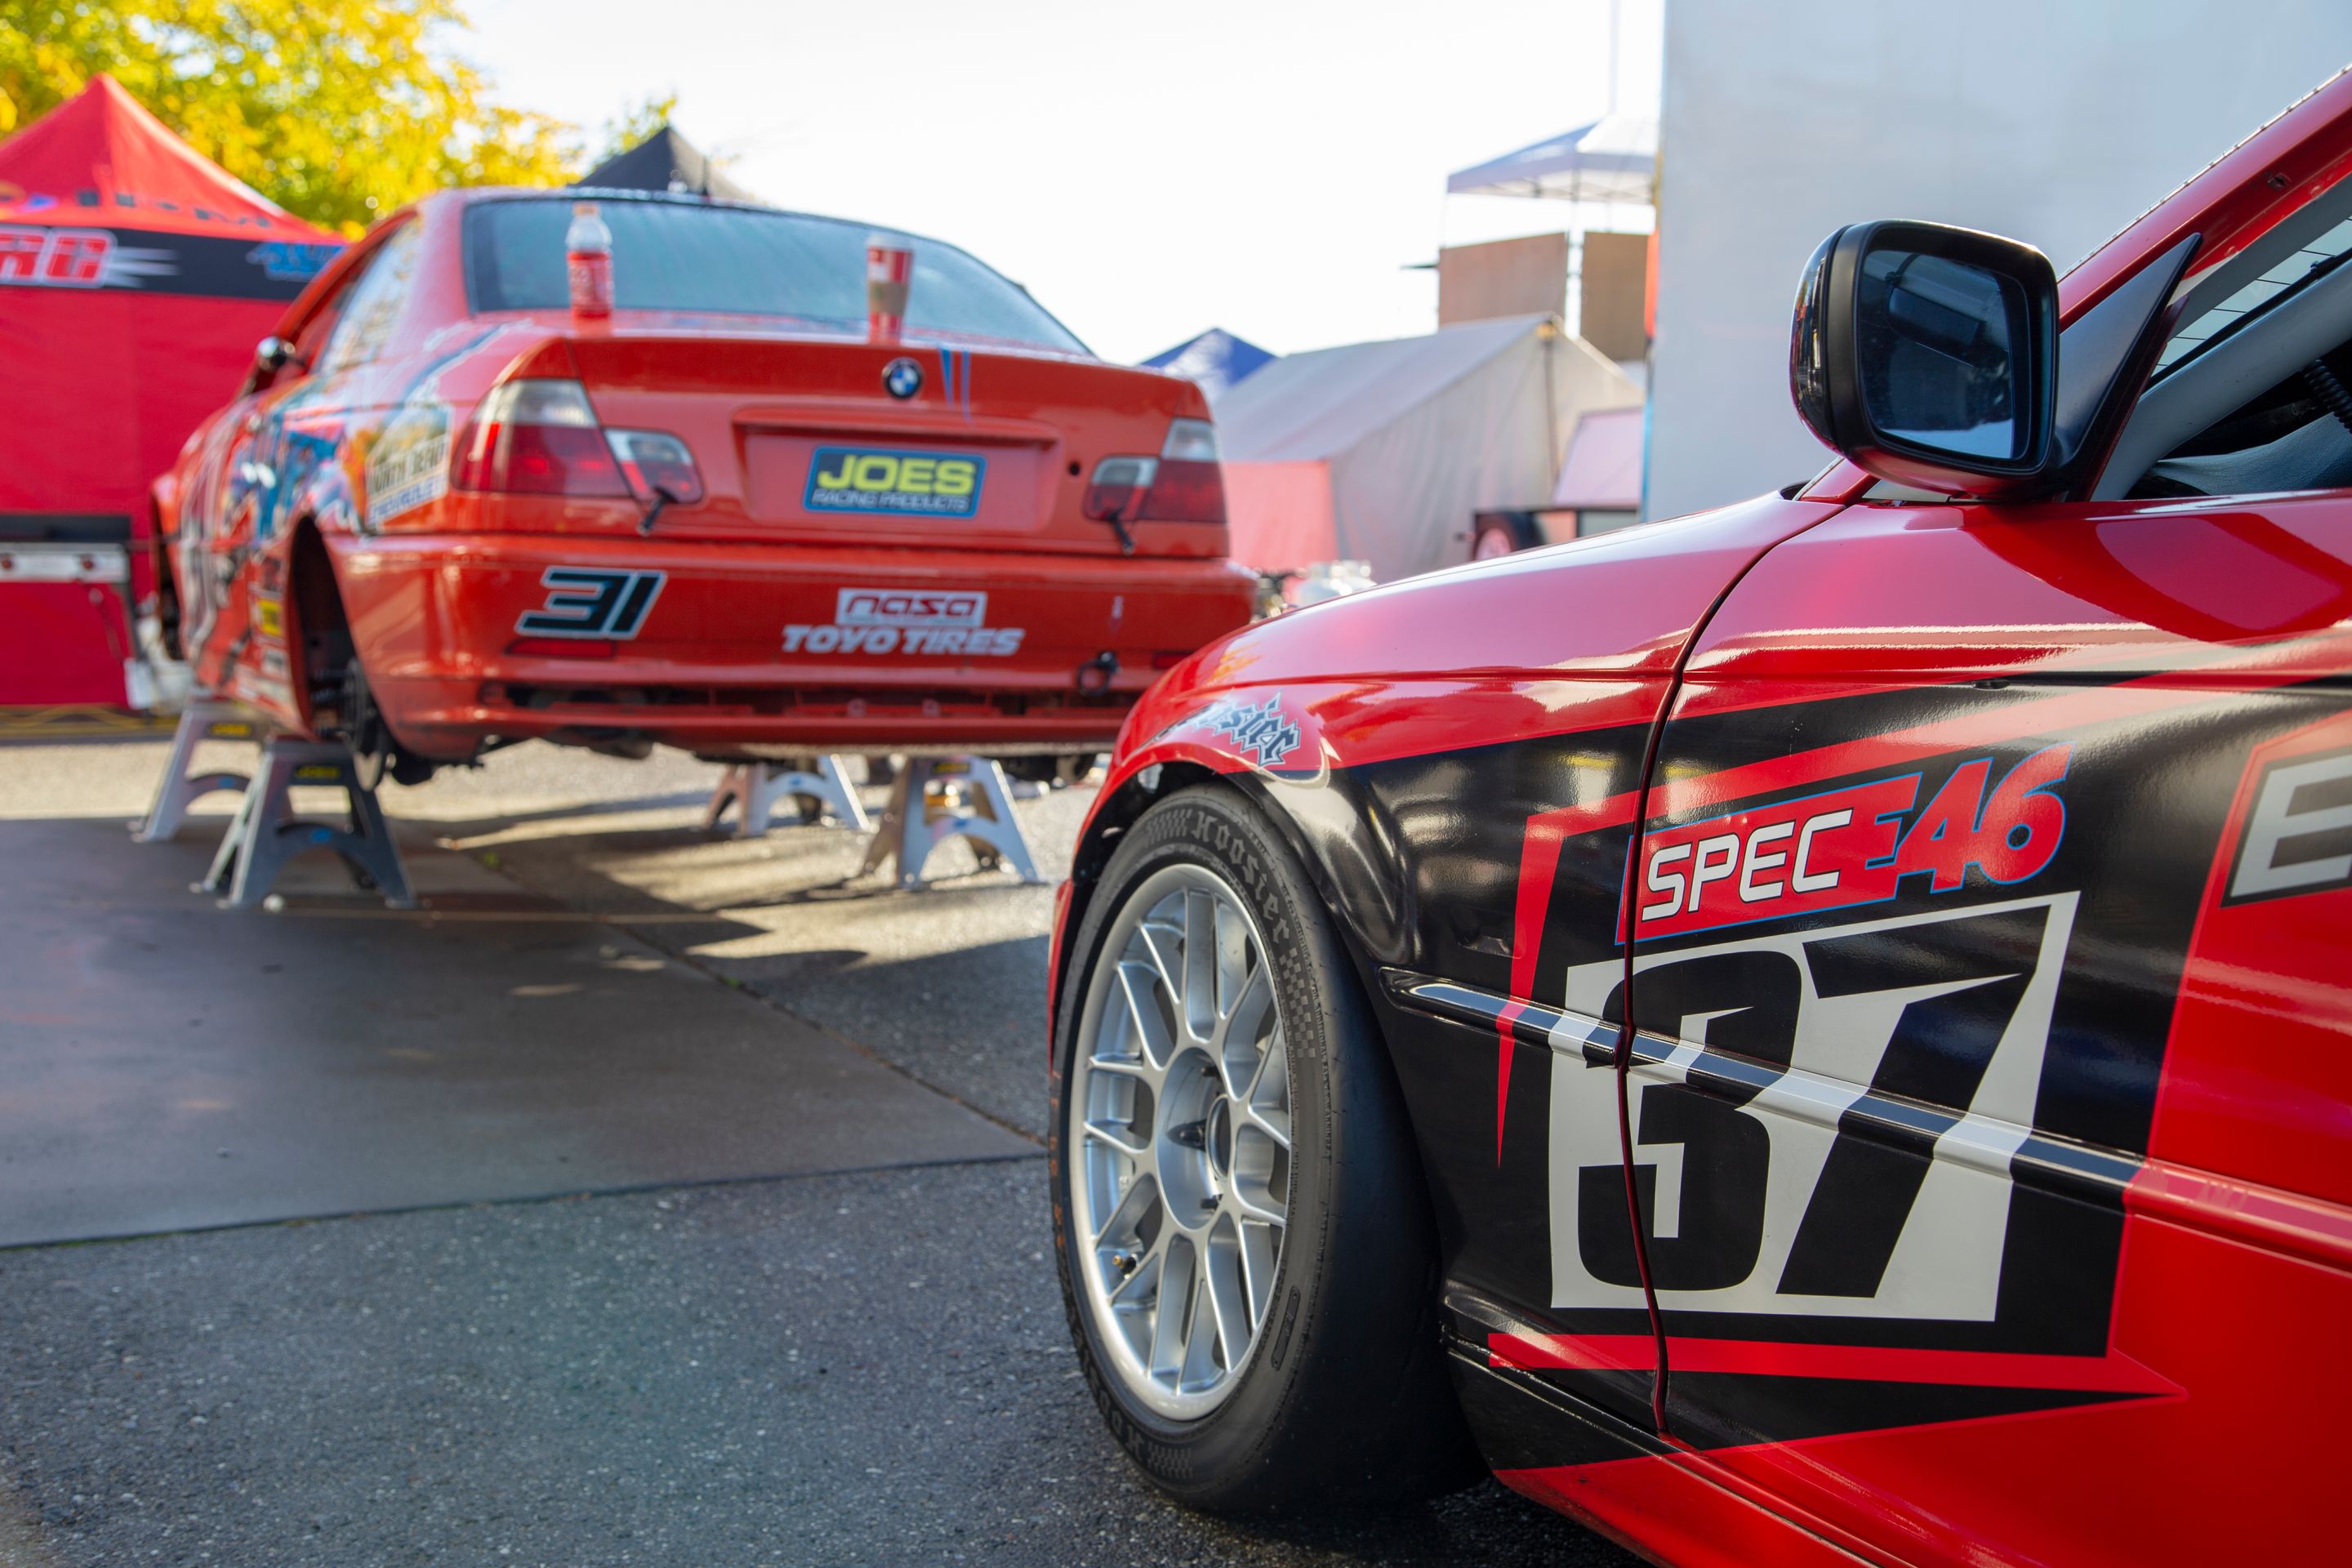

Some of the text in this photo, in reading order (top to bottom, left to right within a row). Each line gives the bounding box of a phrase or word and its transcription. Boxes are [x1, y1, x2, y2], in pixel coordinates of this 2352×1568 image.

[811, 488, 970, 513] RACING PRODUCTS
[817, 455, 977, 495] JOES
[514, 565, 668, 640] 31
[782, 624, 1026, 656] TOYO TIRES
[1641, 742, 2077, 923] SPEC E46
[1191, 810, 1290, 944] Hoosier
[1578, 904, 2051, 1298] 37
